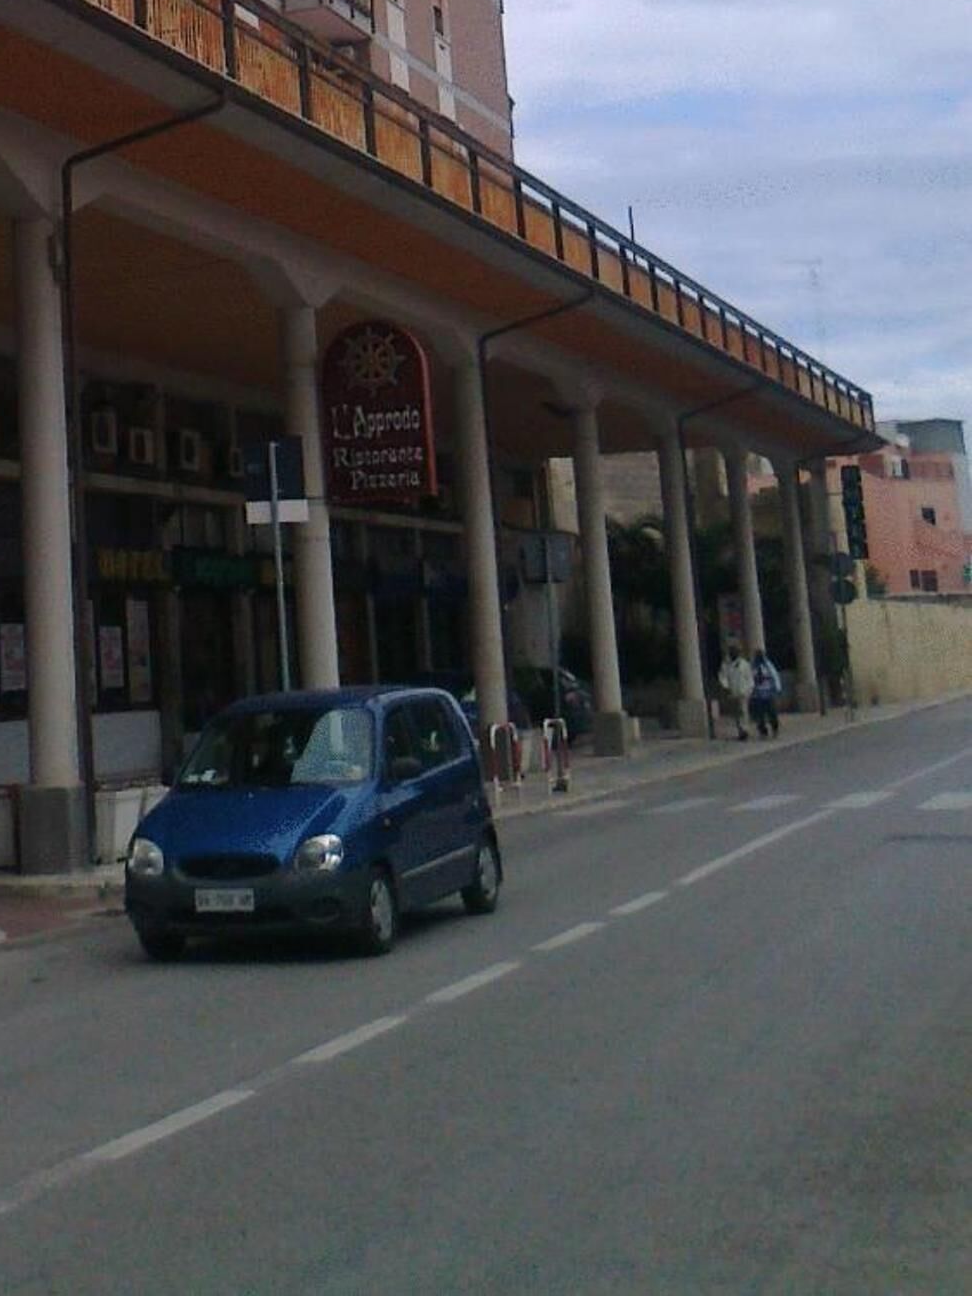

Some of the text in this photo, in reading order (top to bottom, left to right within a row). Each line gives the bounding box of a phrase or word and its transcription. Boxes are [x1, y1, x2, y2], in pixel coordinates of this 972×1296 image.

[332, 404, 420, 439] L'Approdo
[334, 447, 423, 467] Ristorante
[351, 470, 420, 490] Pizzeria
